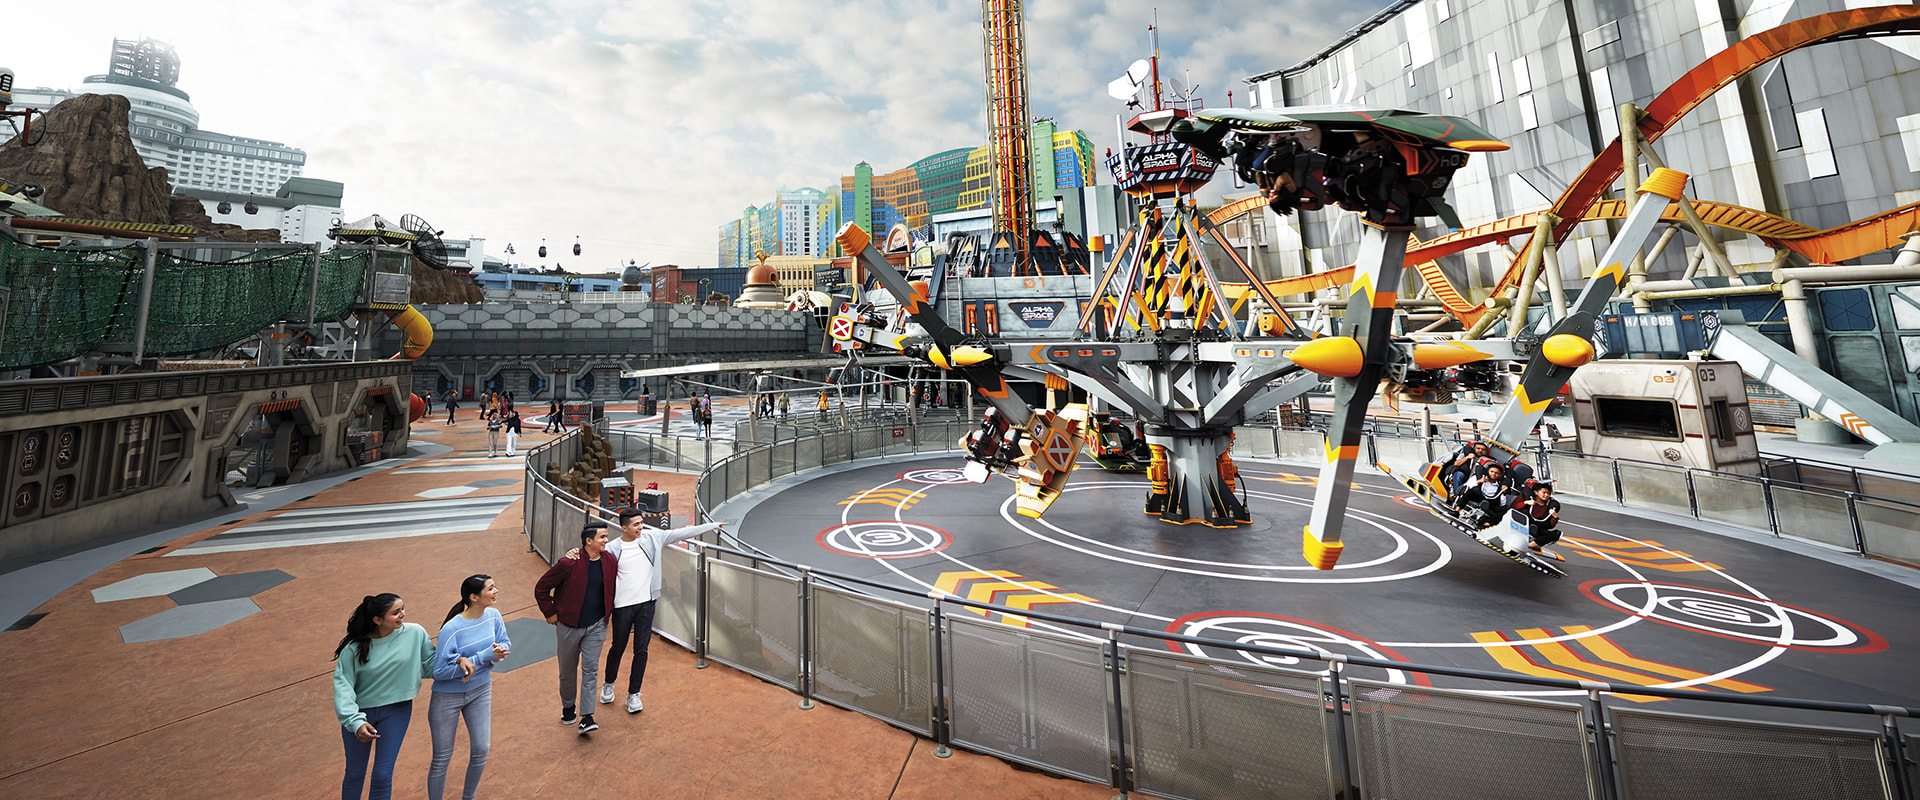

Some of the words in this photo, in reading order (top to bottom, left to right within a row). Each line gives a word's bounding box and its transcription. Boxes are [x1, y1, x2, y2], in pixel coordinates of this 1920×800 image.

[1142, 152, 1177, 162] ALPHA
[1143, 159, 1178, 169] SPACE
[1022, 312, 1055, 321] SPACE
[1653, 375, 1675, 383] 03
[1700, 369, 1716, 382] 03
